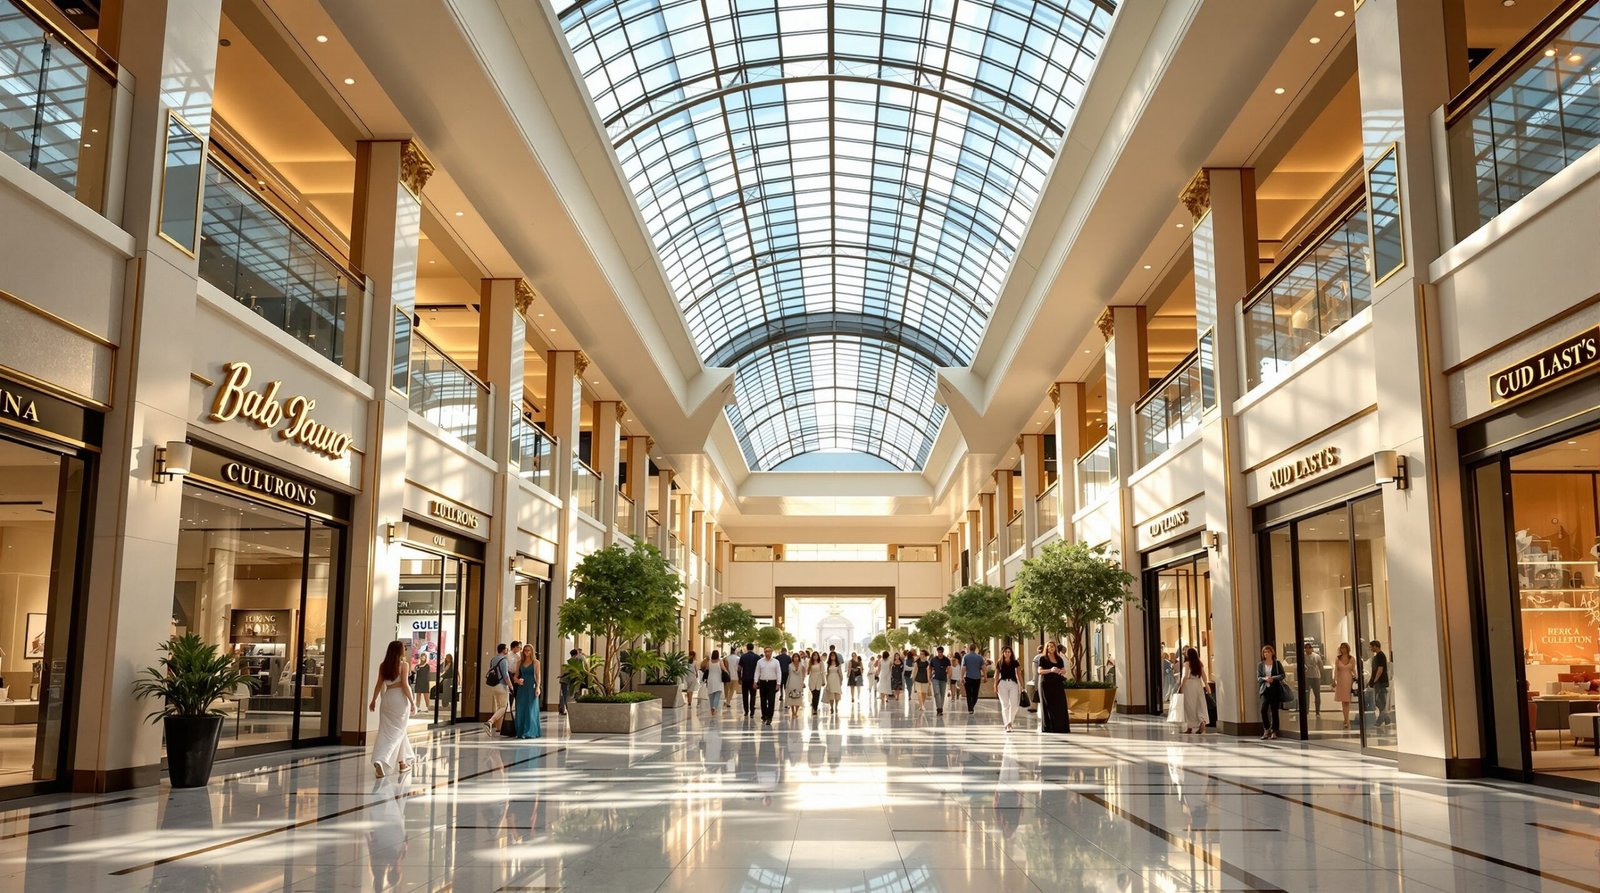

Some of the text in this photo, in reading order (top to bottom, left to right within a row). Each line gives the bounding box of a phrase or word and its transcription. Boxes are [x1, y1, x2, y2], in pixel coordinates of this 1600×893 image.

[1495, 338, 1597, 398] CUD LAST'S
[0, 388, 40, 423] NA
[226, 462, 317, 505] CULURONS
